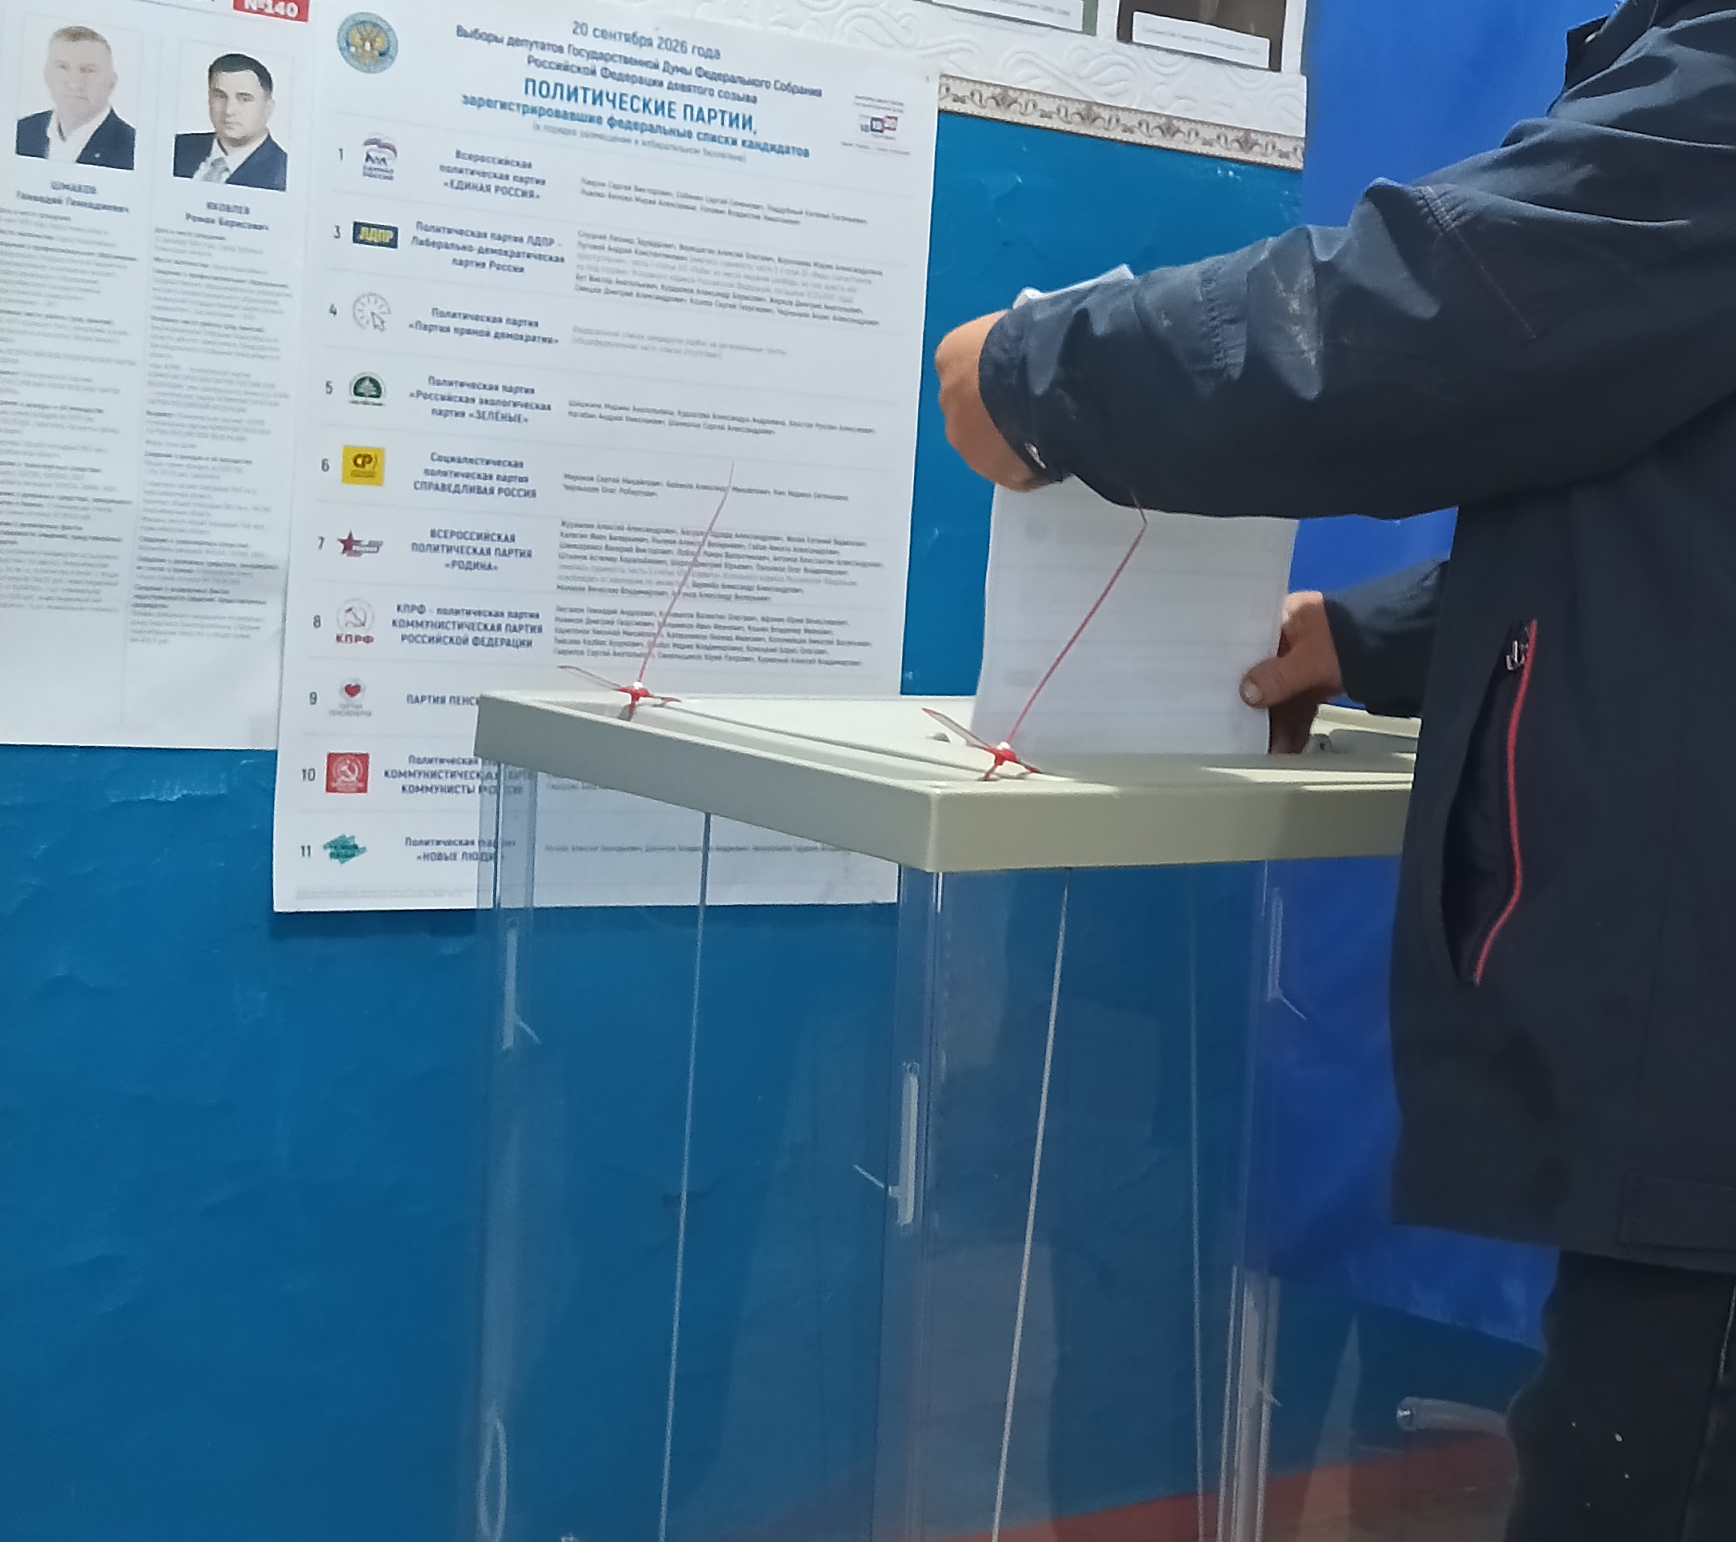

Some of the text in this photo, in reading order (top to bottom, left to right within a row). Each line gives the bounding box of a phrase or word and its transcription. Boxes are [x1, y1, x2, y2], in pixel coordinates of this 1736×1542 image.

[572, 20, 721, 60] 20 сентября 2026 года
[456, 24, 823, 98] Выборы депутатов Государственной Думы Федерального Собрания
[527, 54, 758, 105] Российской Федерации девятого созыва
[524, 77, 757, 135] ПОЛИТИЧЕСКИЕ ПАРТИИ,
[462, 94, 810, 158] зарегистрировавшие федеральные списки кандидатов
[338, 148, 343, 161] 1
[334, 225, 341, 239] 3
[329, 304, 337, 316] 4
[325, 380, 333, 395] 5
[321, 458, 330, 472] 6
[413, 480, 537, 498] СПРАВЕДЛИВАЯ РОССИЯ
[318, 536, 325, 550] 7
[430, 528, 516, 543] ВСЕРОССИЙСКАЯ
[411, 542, 532, 558] ПОЛИТИЧЕСКАЯ ПАРТИЯ
[396, 604, 426, 615] КПРФ
[313, 614, 321, 629] 8
[392, 618, 543, 634] КОММУНИСТИЧЕСКАЯ ПАРТИЯ
[335, 633, 374, 644] КПРФ
[401, 633, 533, 649] РОССИЙСКОЙ ФЕДЕРАЦИИ
[309, 691, 318, 705] 9
[406, 694, 446, 705] ПАРТИЯ
[302, 767, 316, 782] 10
[401, 784, 475, 794] КОММУНИСТЫ
[301, 845, 311, 858] 11
